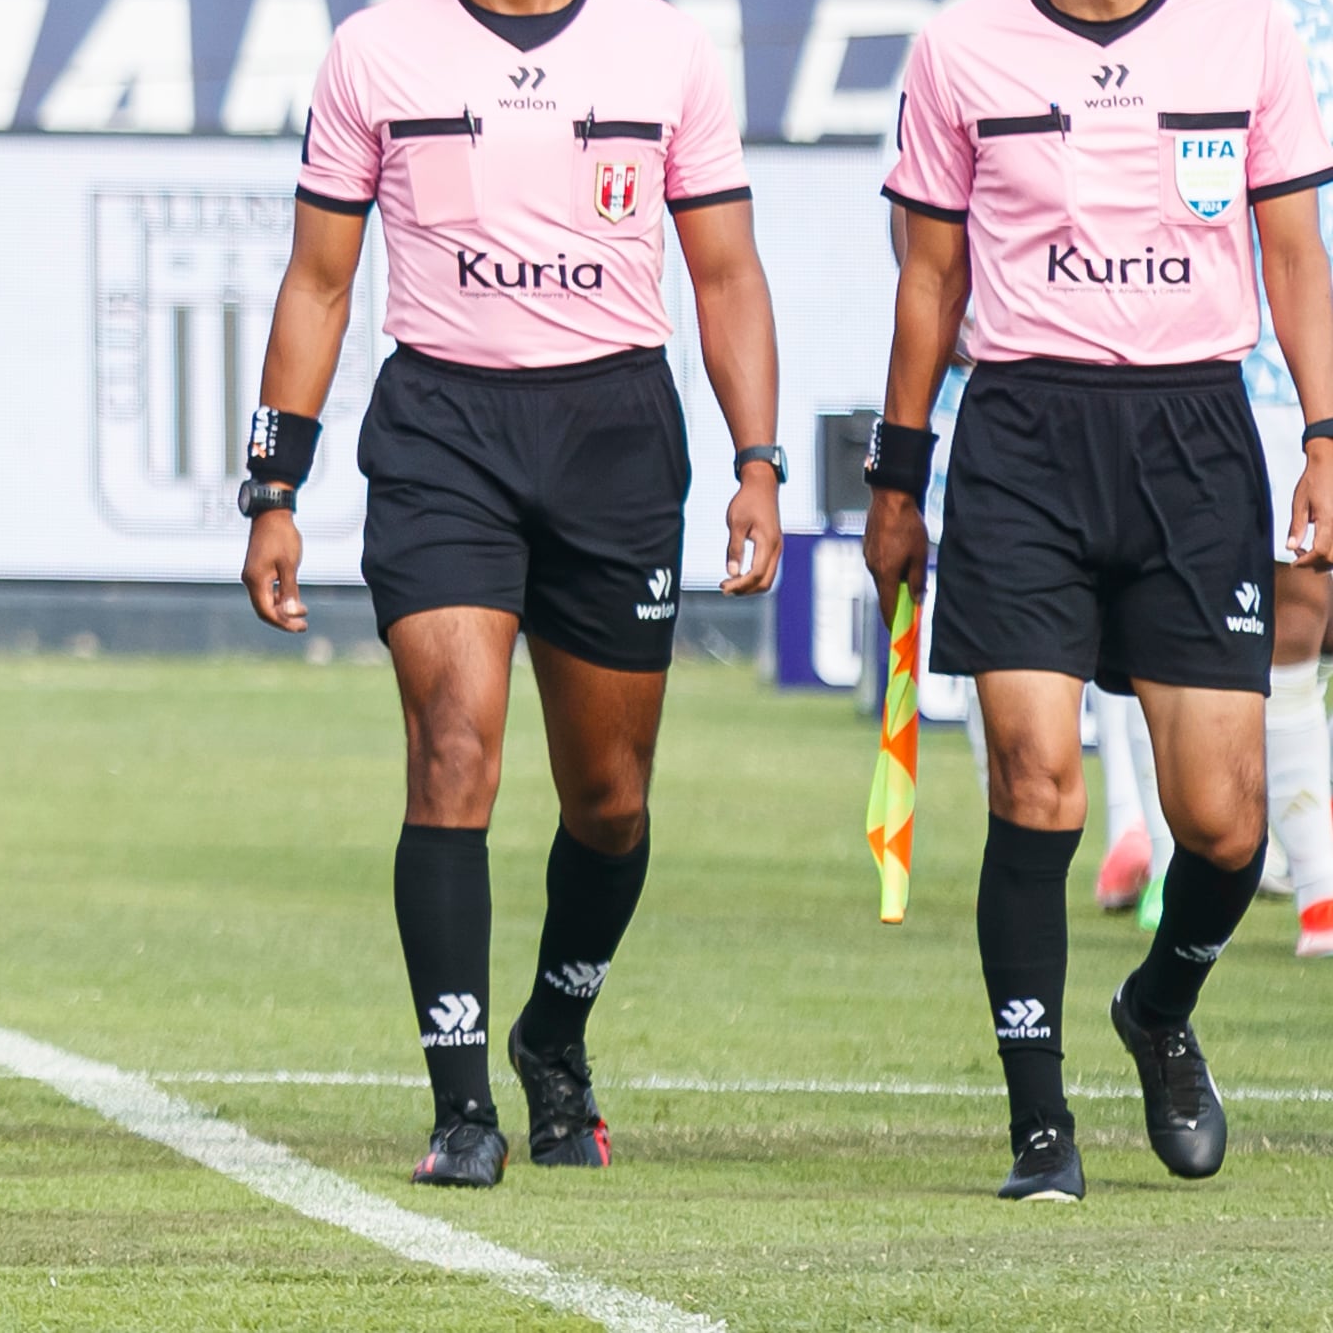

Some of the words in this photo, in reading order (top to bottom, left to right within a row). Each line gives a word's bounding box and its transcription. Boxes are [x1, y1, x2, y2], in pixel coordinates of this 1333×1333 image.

[498, 96, 556, 111] walon
[1084, 94, 1144, 108] walon
[1182, 139, 1235, 159] FIFA
[457, 250, 604, 289] Kuria
[1046, 243, 1191, 285] Kuria
[421, 1028, 486, 1047] walon
[997, 1024, 1051, 1039] walon
